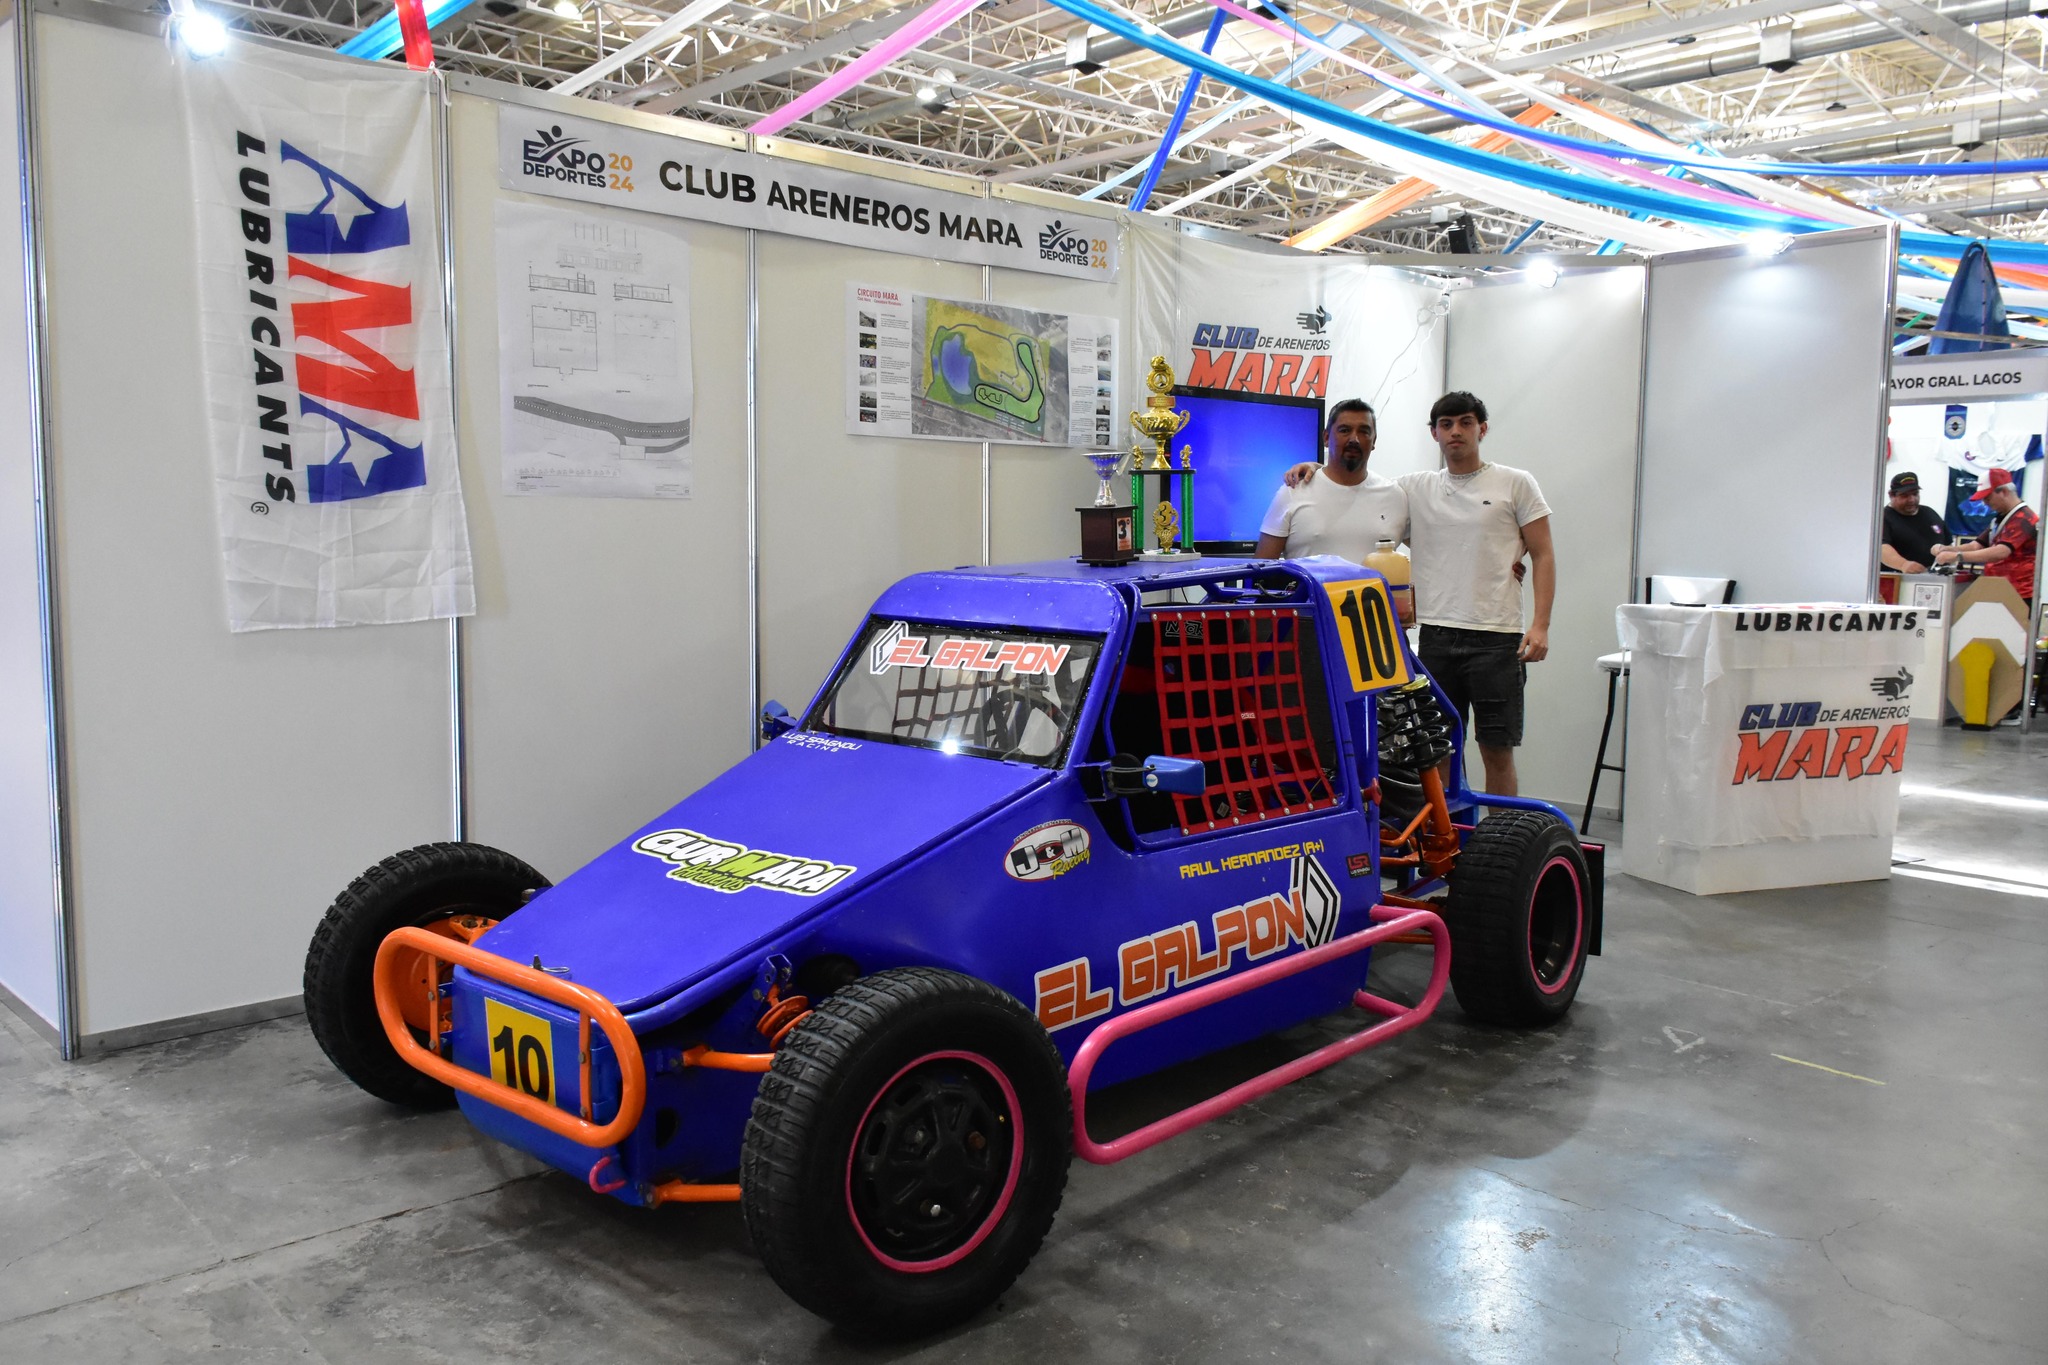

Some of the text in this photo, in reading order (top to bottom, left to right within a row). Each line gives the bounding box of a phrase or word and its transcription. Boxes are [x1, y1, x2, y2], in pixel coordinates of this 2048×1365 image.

[523, 128, 633, 173] EXPO 20
[523, 161, 635, 193] DEPORTES 24
[659, 160, 1024, 249] CLUB ARENEROS MARA
[1038, 220, 1108, 256] EXPO 20
[1039, 249, 1108, 270] DEPORTES 24
[857, 288, 898, 301] CIRCUITO MARA
[236, 130, 296, 503] LUBRICANTS
[1192, 322, 1331, 350] CLUB DE ARENEROS
[1186, 347, 1333, 399] MARA
[1928, 375, 1969, 388] GRAL.
[1973, 371, 2022, 386] LAGOS
[1340, 586, 1397, 682] 10
[1735, 611, 1918, 633] LUBRICANTS
[888, 638, 1071, 675] EL GALPON
[1738, 701, 1911, 731] CLUB DE ARENEROS
[781, 731, 862, 750] LUIS SPAGNOLI
[786, 740, 839, 752] RACING
[1731, 723, 1910, 786] MARA
[637, 831, 853, 894] CLUB MARA
[1010, 844, 1041, 878] J
[1045, 845, 1056, 859] &
[1060, 827, 1085, 859] M
[1050, 848, 1091, 880] Racing
[1179, 860, 1219, 879] RAUL
[1220, 843, 1302, 871] HERNANDEZ
[1347, 855, 1370, 870] LSR
[1034, 889, 1307, 1032] EL GALPON
[493, 1025, 550, 1103] 10
